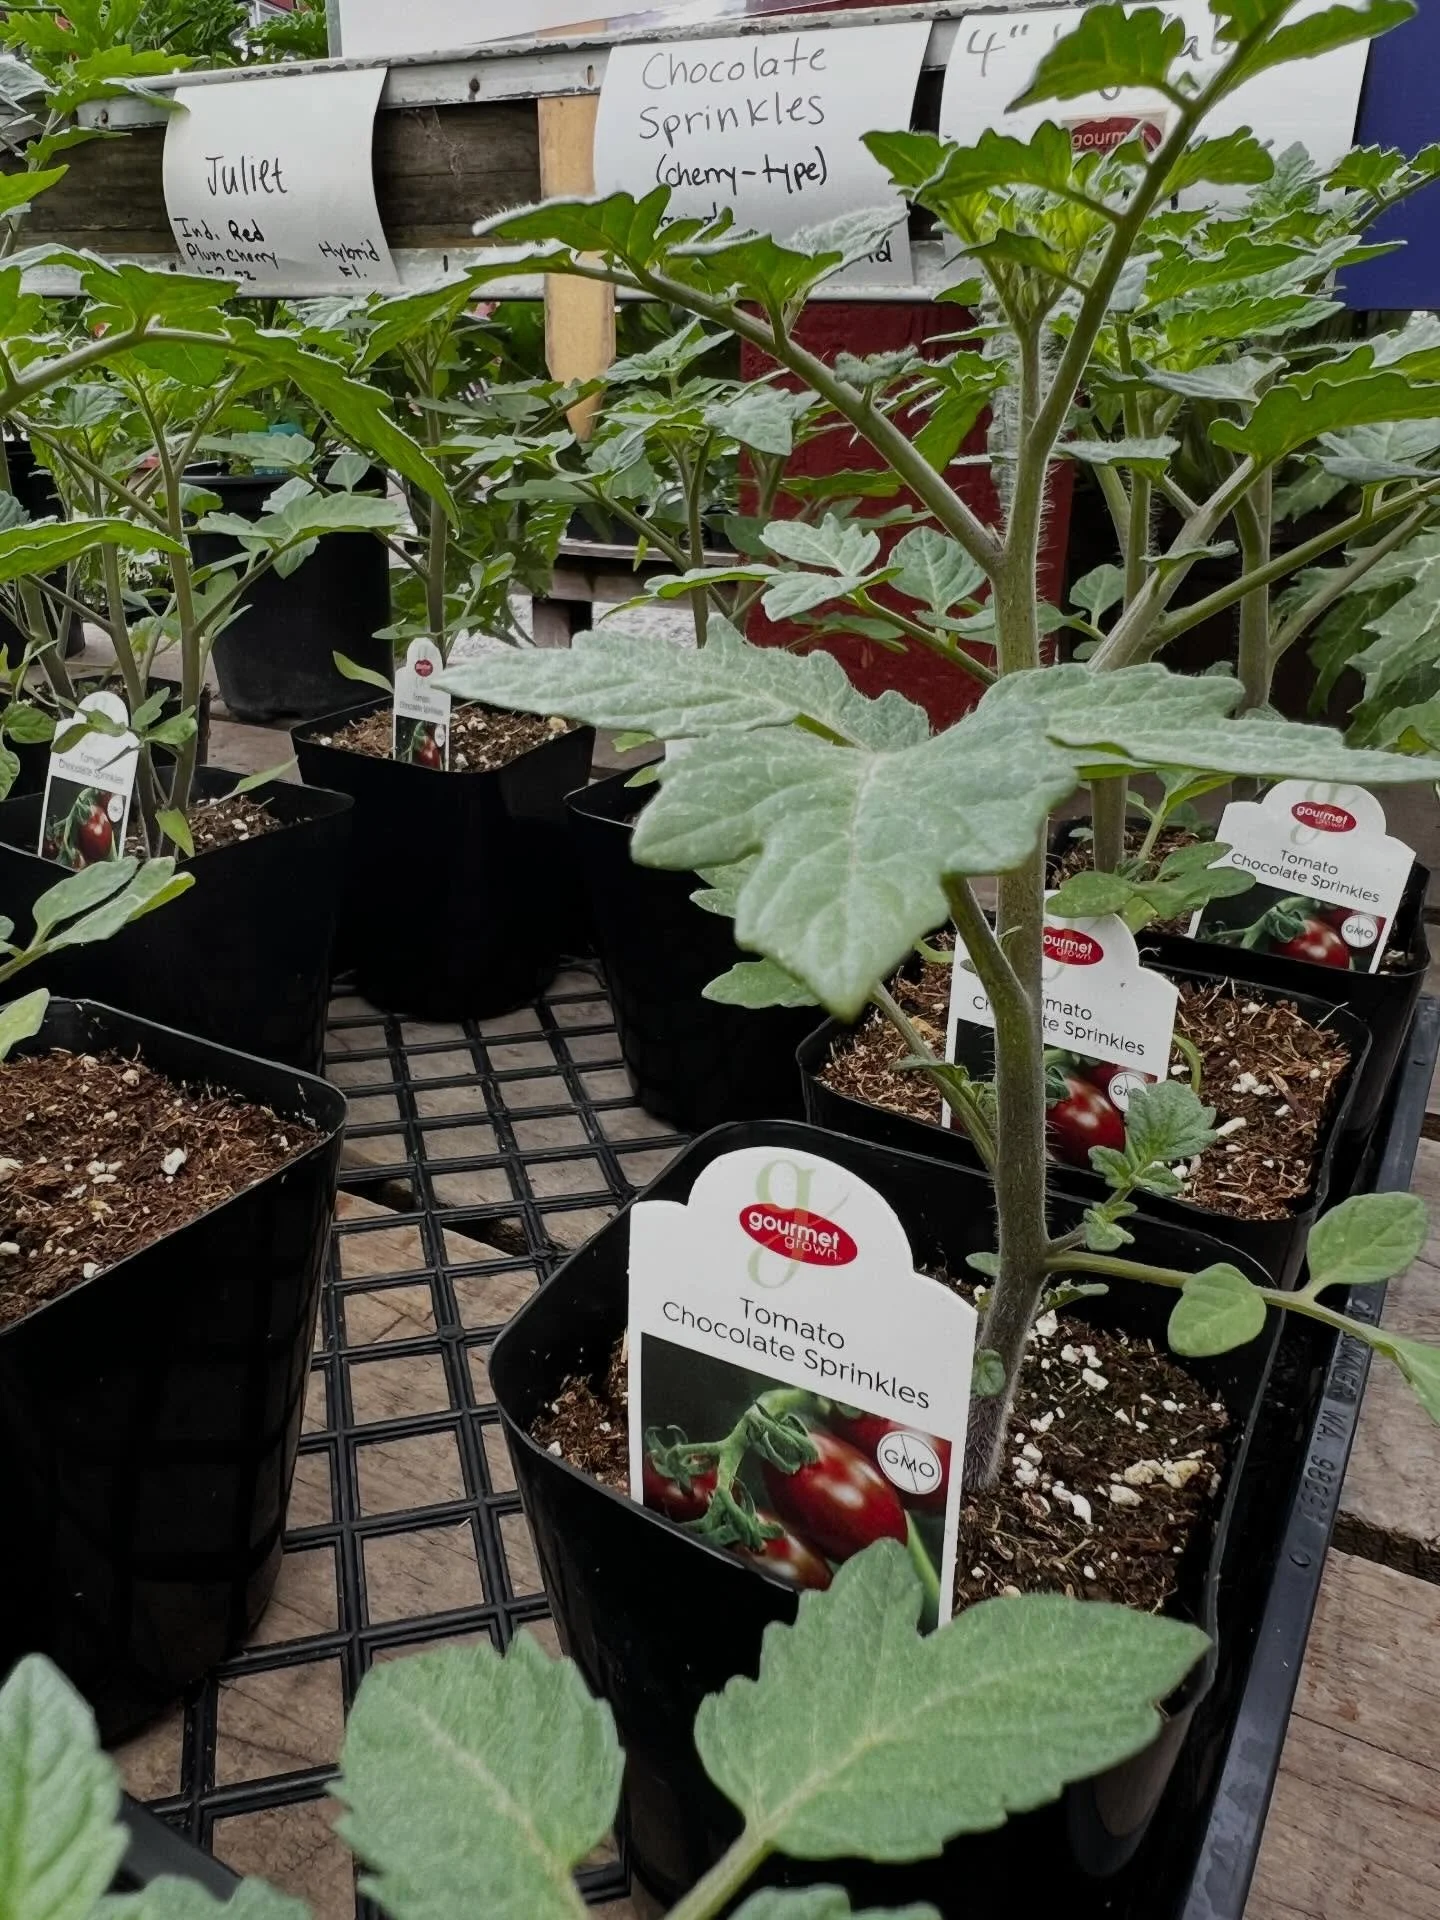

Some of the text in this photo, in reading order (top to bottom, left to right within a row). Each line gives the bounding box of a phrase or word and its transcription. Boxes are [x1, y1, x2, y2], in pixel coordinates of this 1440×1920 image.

[642, 37, 828, 90] Chocolate
[639, 92, 826, 148] Sprinkles
[1071, 129, 1130, 150] gourm
[205, 156, 288, 196] Juliet
[656, 145, 828, 196] (cherry-type)
[228, 219, 265, 243] Red
[318, 239, 381, 265] Hybrid
[1296, 805, 1348, 825] gourmet
[1231, 852, 1380, 904] Chocolate Sprinkles
[1280, 849, 1339, 876] Tomato
[1043, 934, 1094, 953] ourmet
[1345, 923, 1374, 939] GMO
[1044, 998, 1093, 1021] mato
[1064, 1021, 1146, 1056] Sprinkles
[748, 1211, 840, 1250] gourmet
[783, 1234, 839, 1260] grown
[740, 1297, 845, 1350] Tomato
[662, 1301, 930, 1410] Chocolate Sprinkles
[884, 1448, 936, 1479] GMO
